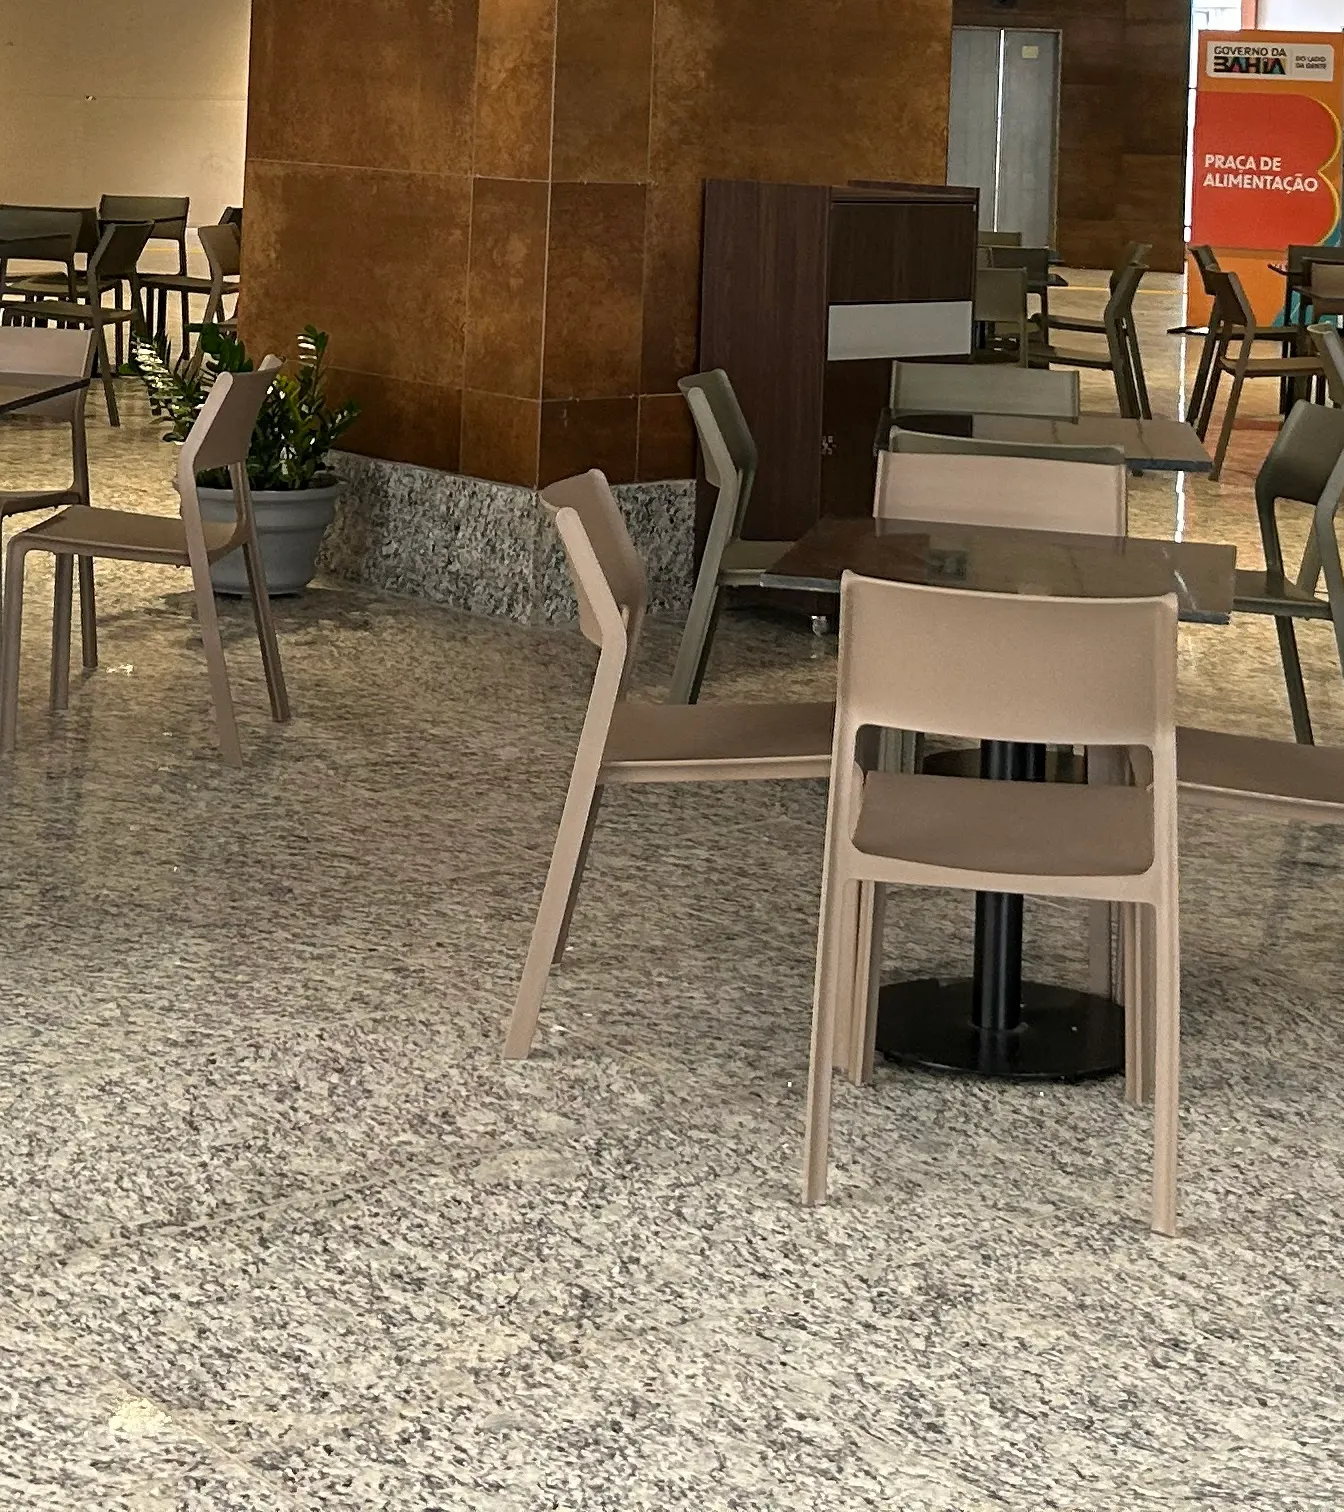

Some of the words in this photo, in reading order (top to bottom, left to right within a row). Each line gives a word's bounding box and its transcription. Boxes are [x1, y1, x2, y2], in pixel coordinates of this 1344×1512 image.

[1214, 46, 1268, 56] GOVERNO
[1271, 47, 1287, 57] DA
[1214, 55, 1286, 75] BAHIA
[1204, 154, 1257, 173] PRAÇA
[1260, 156, 1282, 172] DE
[1202, 173, 1319, 195] ALIMENTAÇÃO
